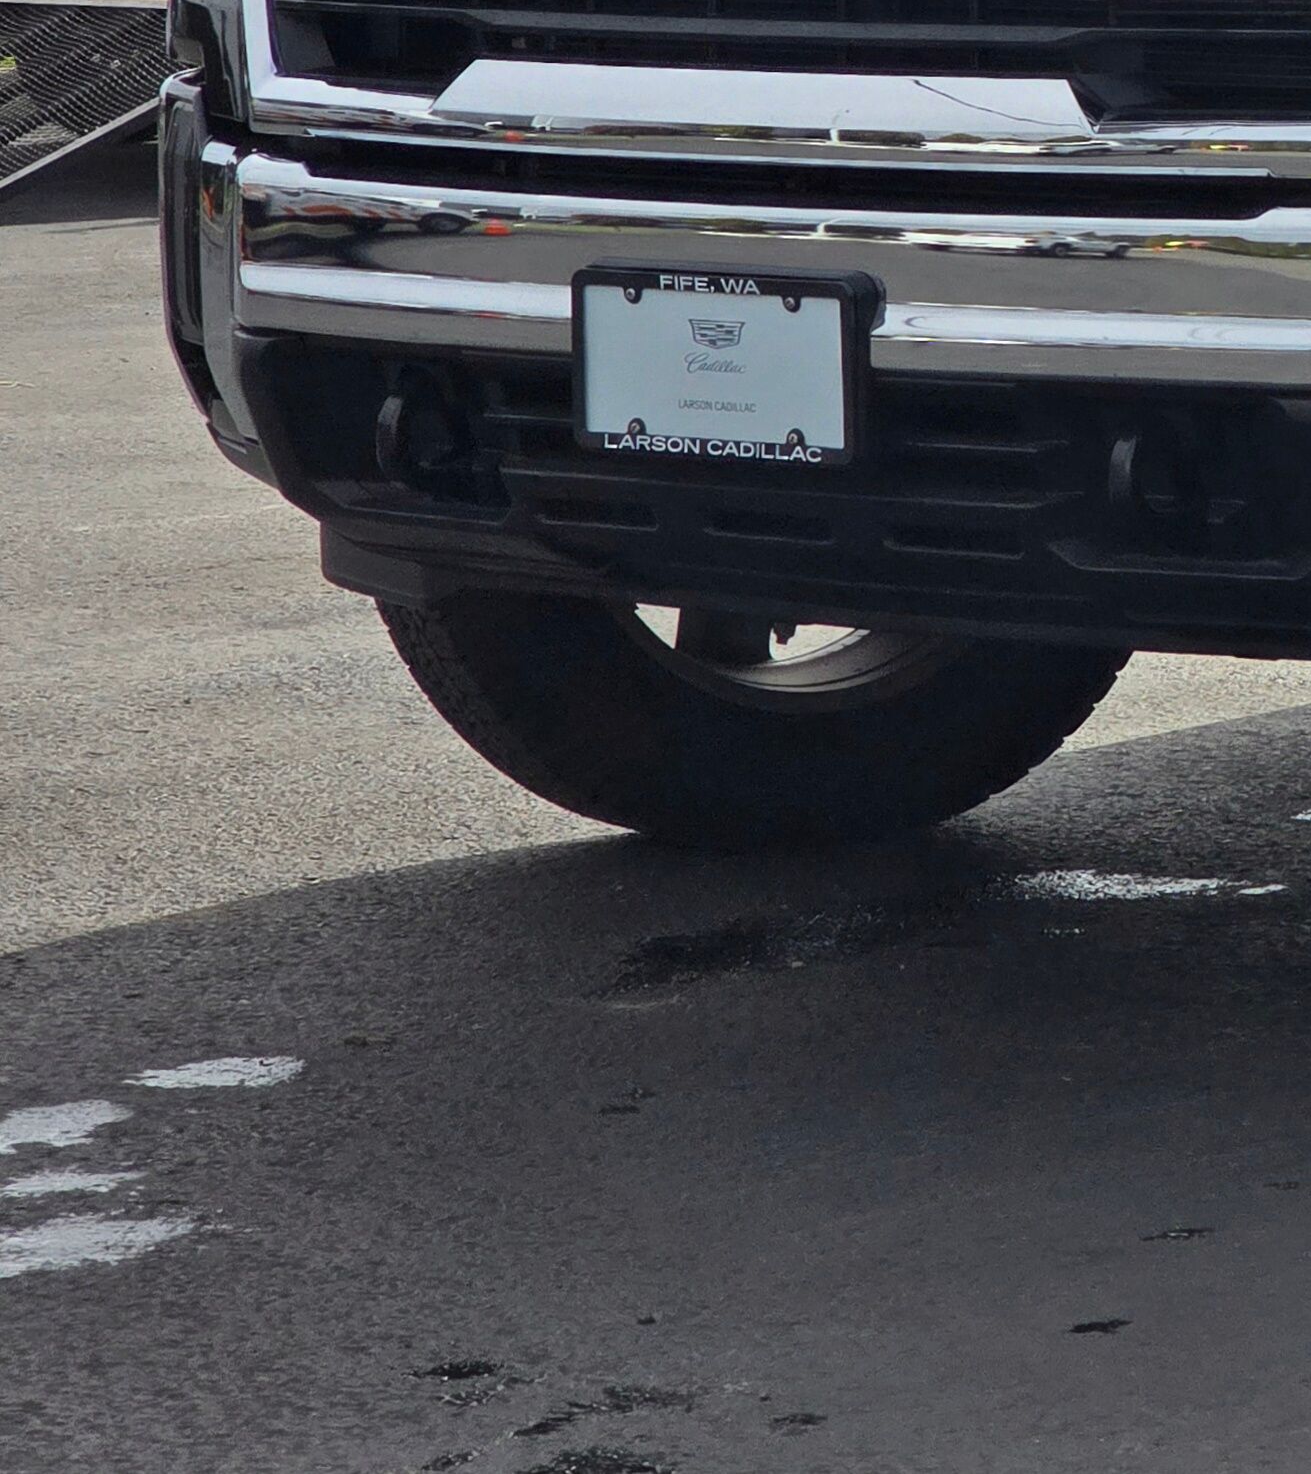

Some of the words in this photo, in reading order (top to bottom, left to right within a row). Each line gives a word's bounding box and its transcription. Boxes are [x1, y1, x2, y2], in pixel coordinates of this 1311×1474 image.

[659, 274, 715, 294] FIFE,
[721, 277, 761, 296] WA
[684, 352, 747, 376] Cadillac
[678, 399, 713, 411] LARSON
[715, 401, 758, 414] CADILLAC
[603, 433, 700, 455] LARSON
[707, 440, 823, 463] CADILLAC
